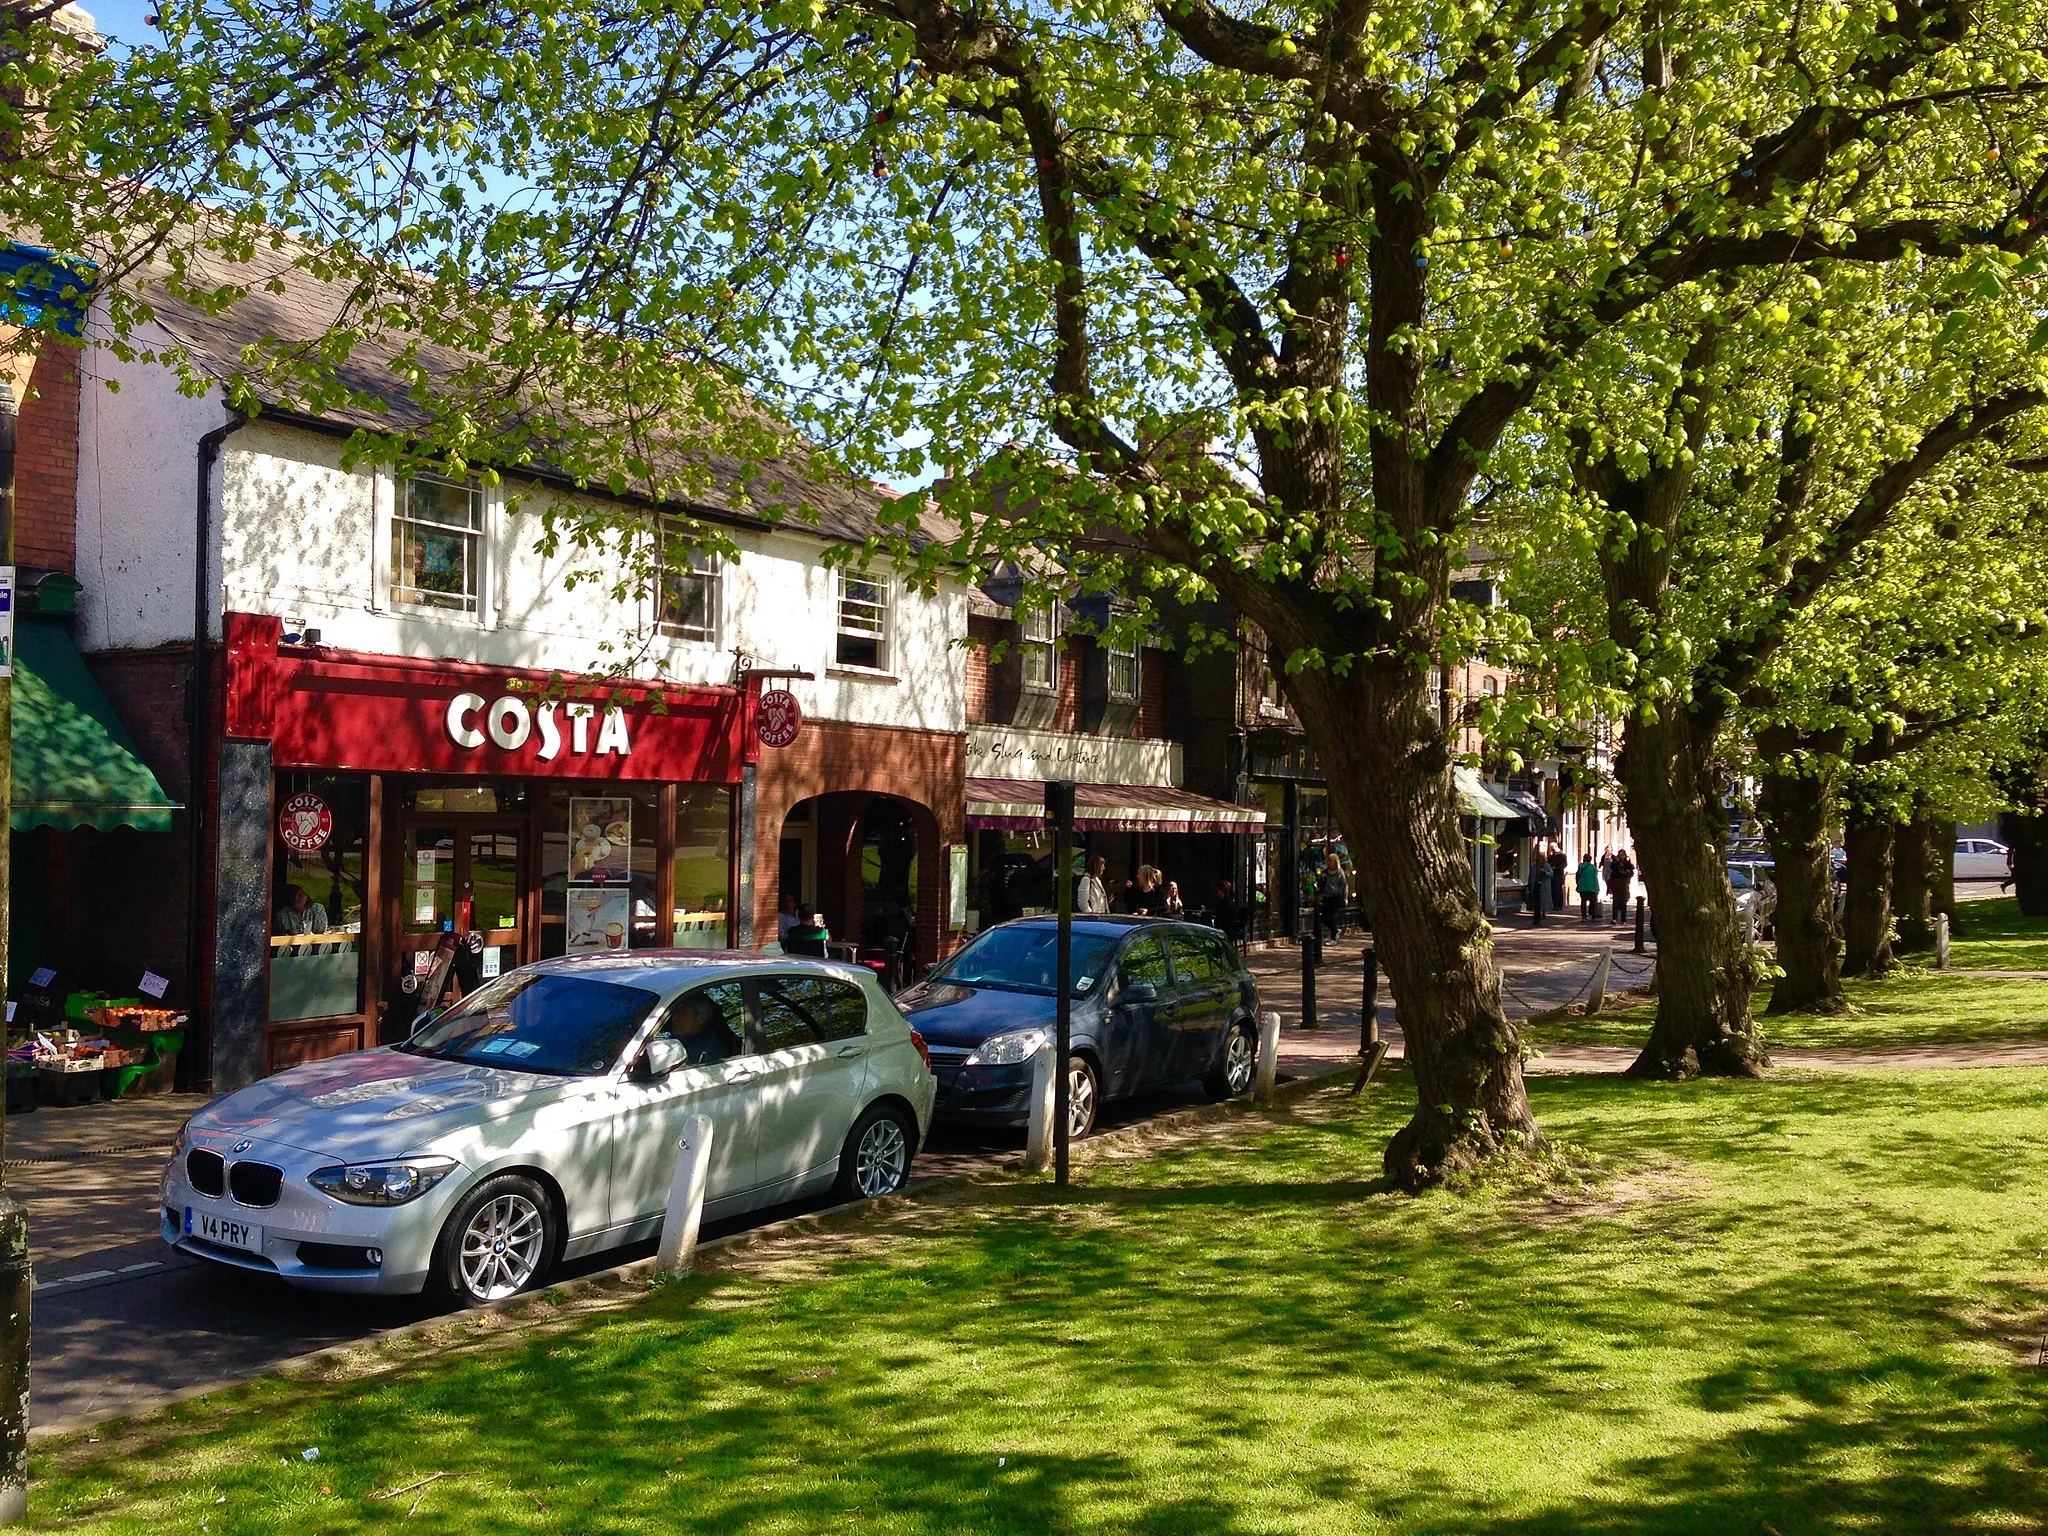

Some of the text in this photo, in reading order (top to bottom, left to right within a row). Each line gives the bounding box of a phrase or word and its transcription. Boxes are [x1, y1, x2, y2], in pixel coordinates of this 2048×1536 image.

[761, 693, 790, 710] COSTA
[446, 692, 632, 760] COSTA
[759, 723, 794, 743] COFFEE
[991, 735, 1023, 769] Slug
[1028, 744, 1053, 762] and
[287, 796, 324, 813] COSTA
[284, 828, 328, 848] COFFEE
[201, 1215, 249, 1245] V4 PRY
